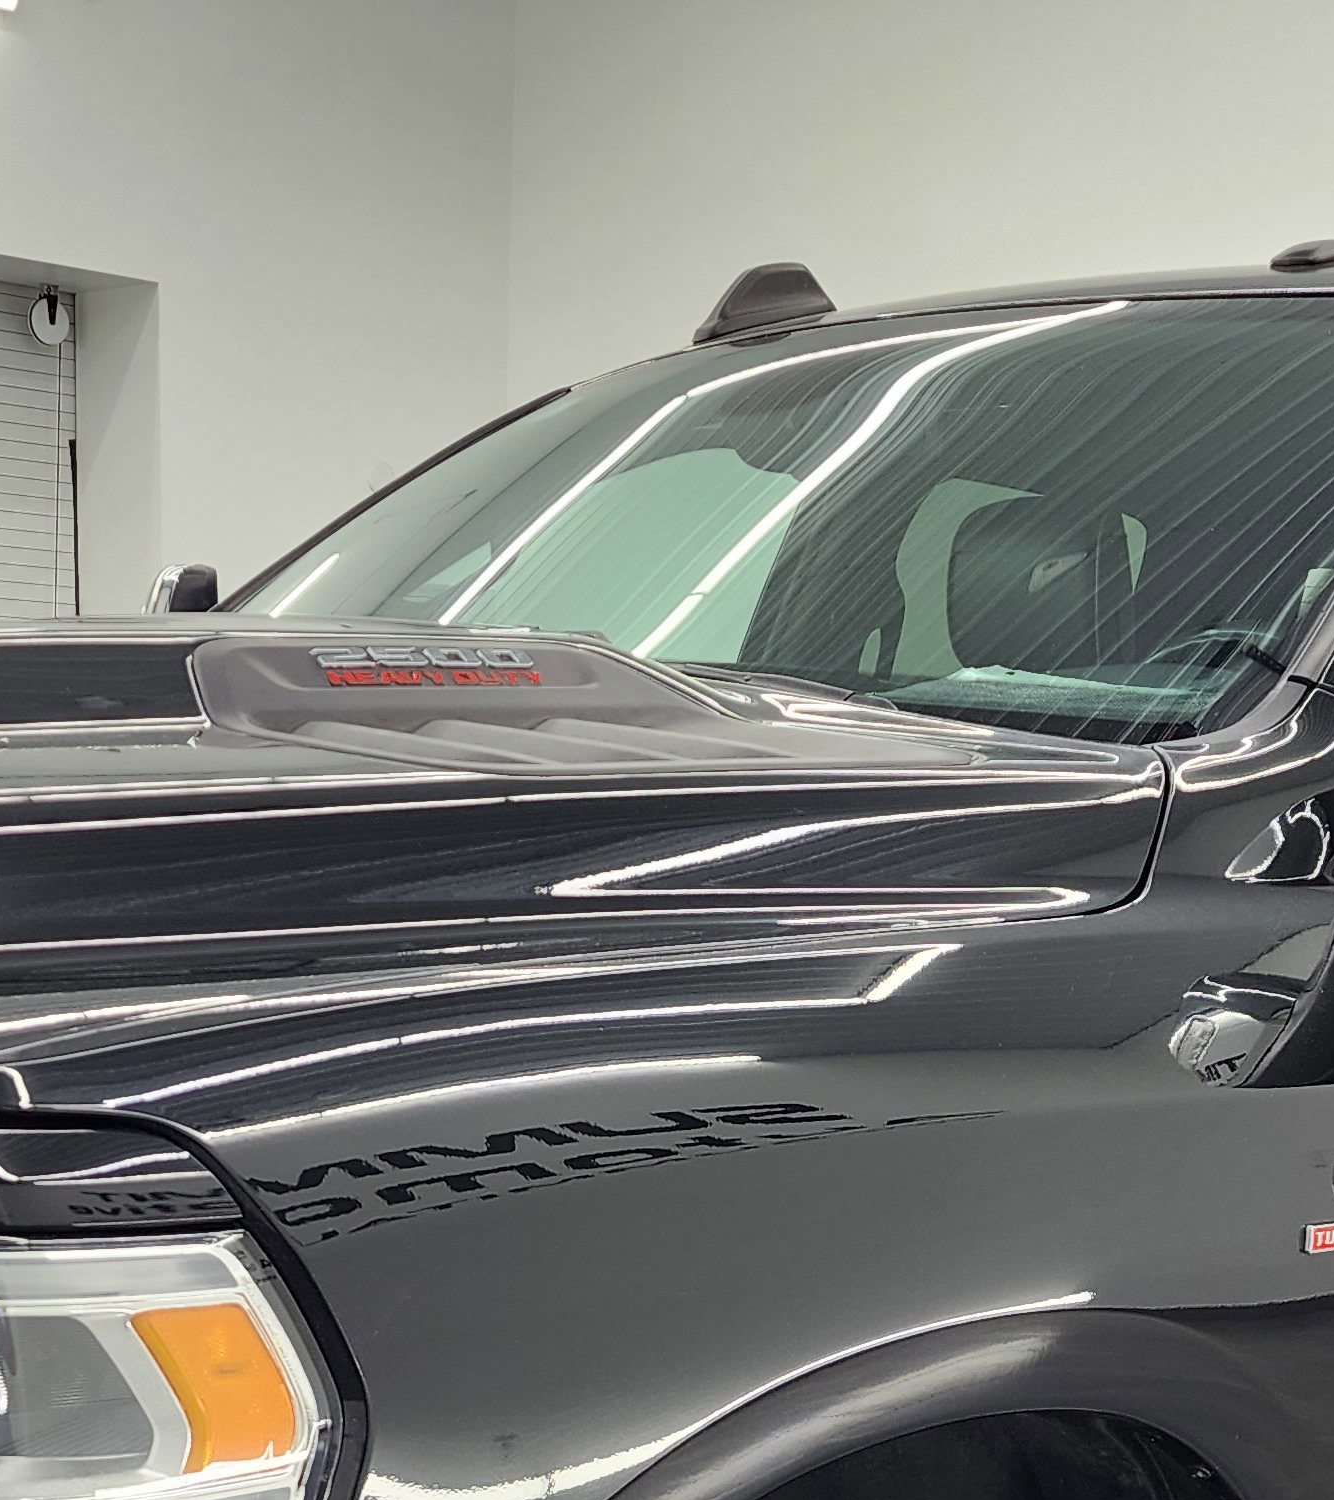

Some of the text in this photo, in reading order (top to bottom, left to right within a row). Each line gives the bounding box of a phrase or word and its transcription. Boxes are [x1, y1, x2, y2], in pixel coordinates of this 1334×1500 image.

[308, 646, 534, 669] 2500
[325, 669, 542, 687] HEAVY DUTY
